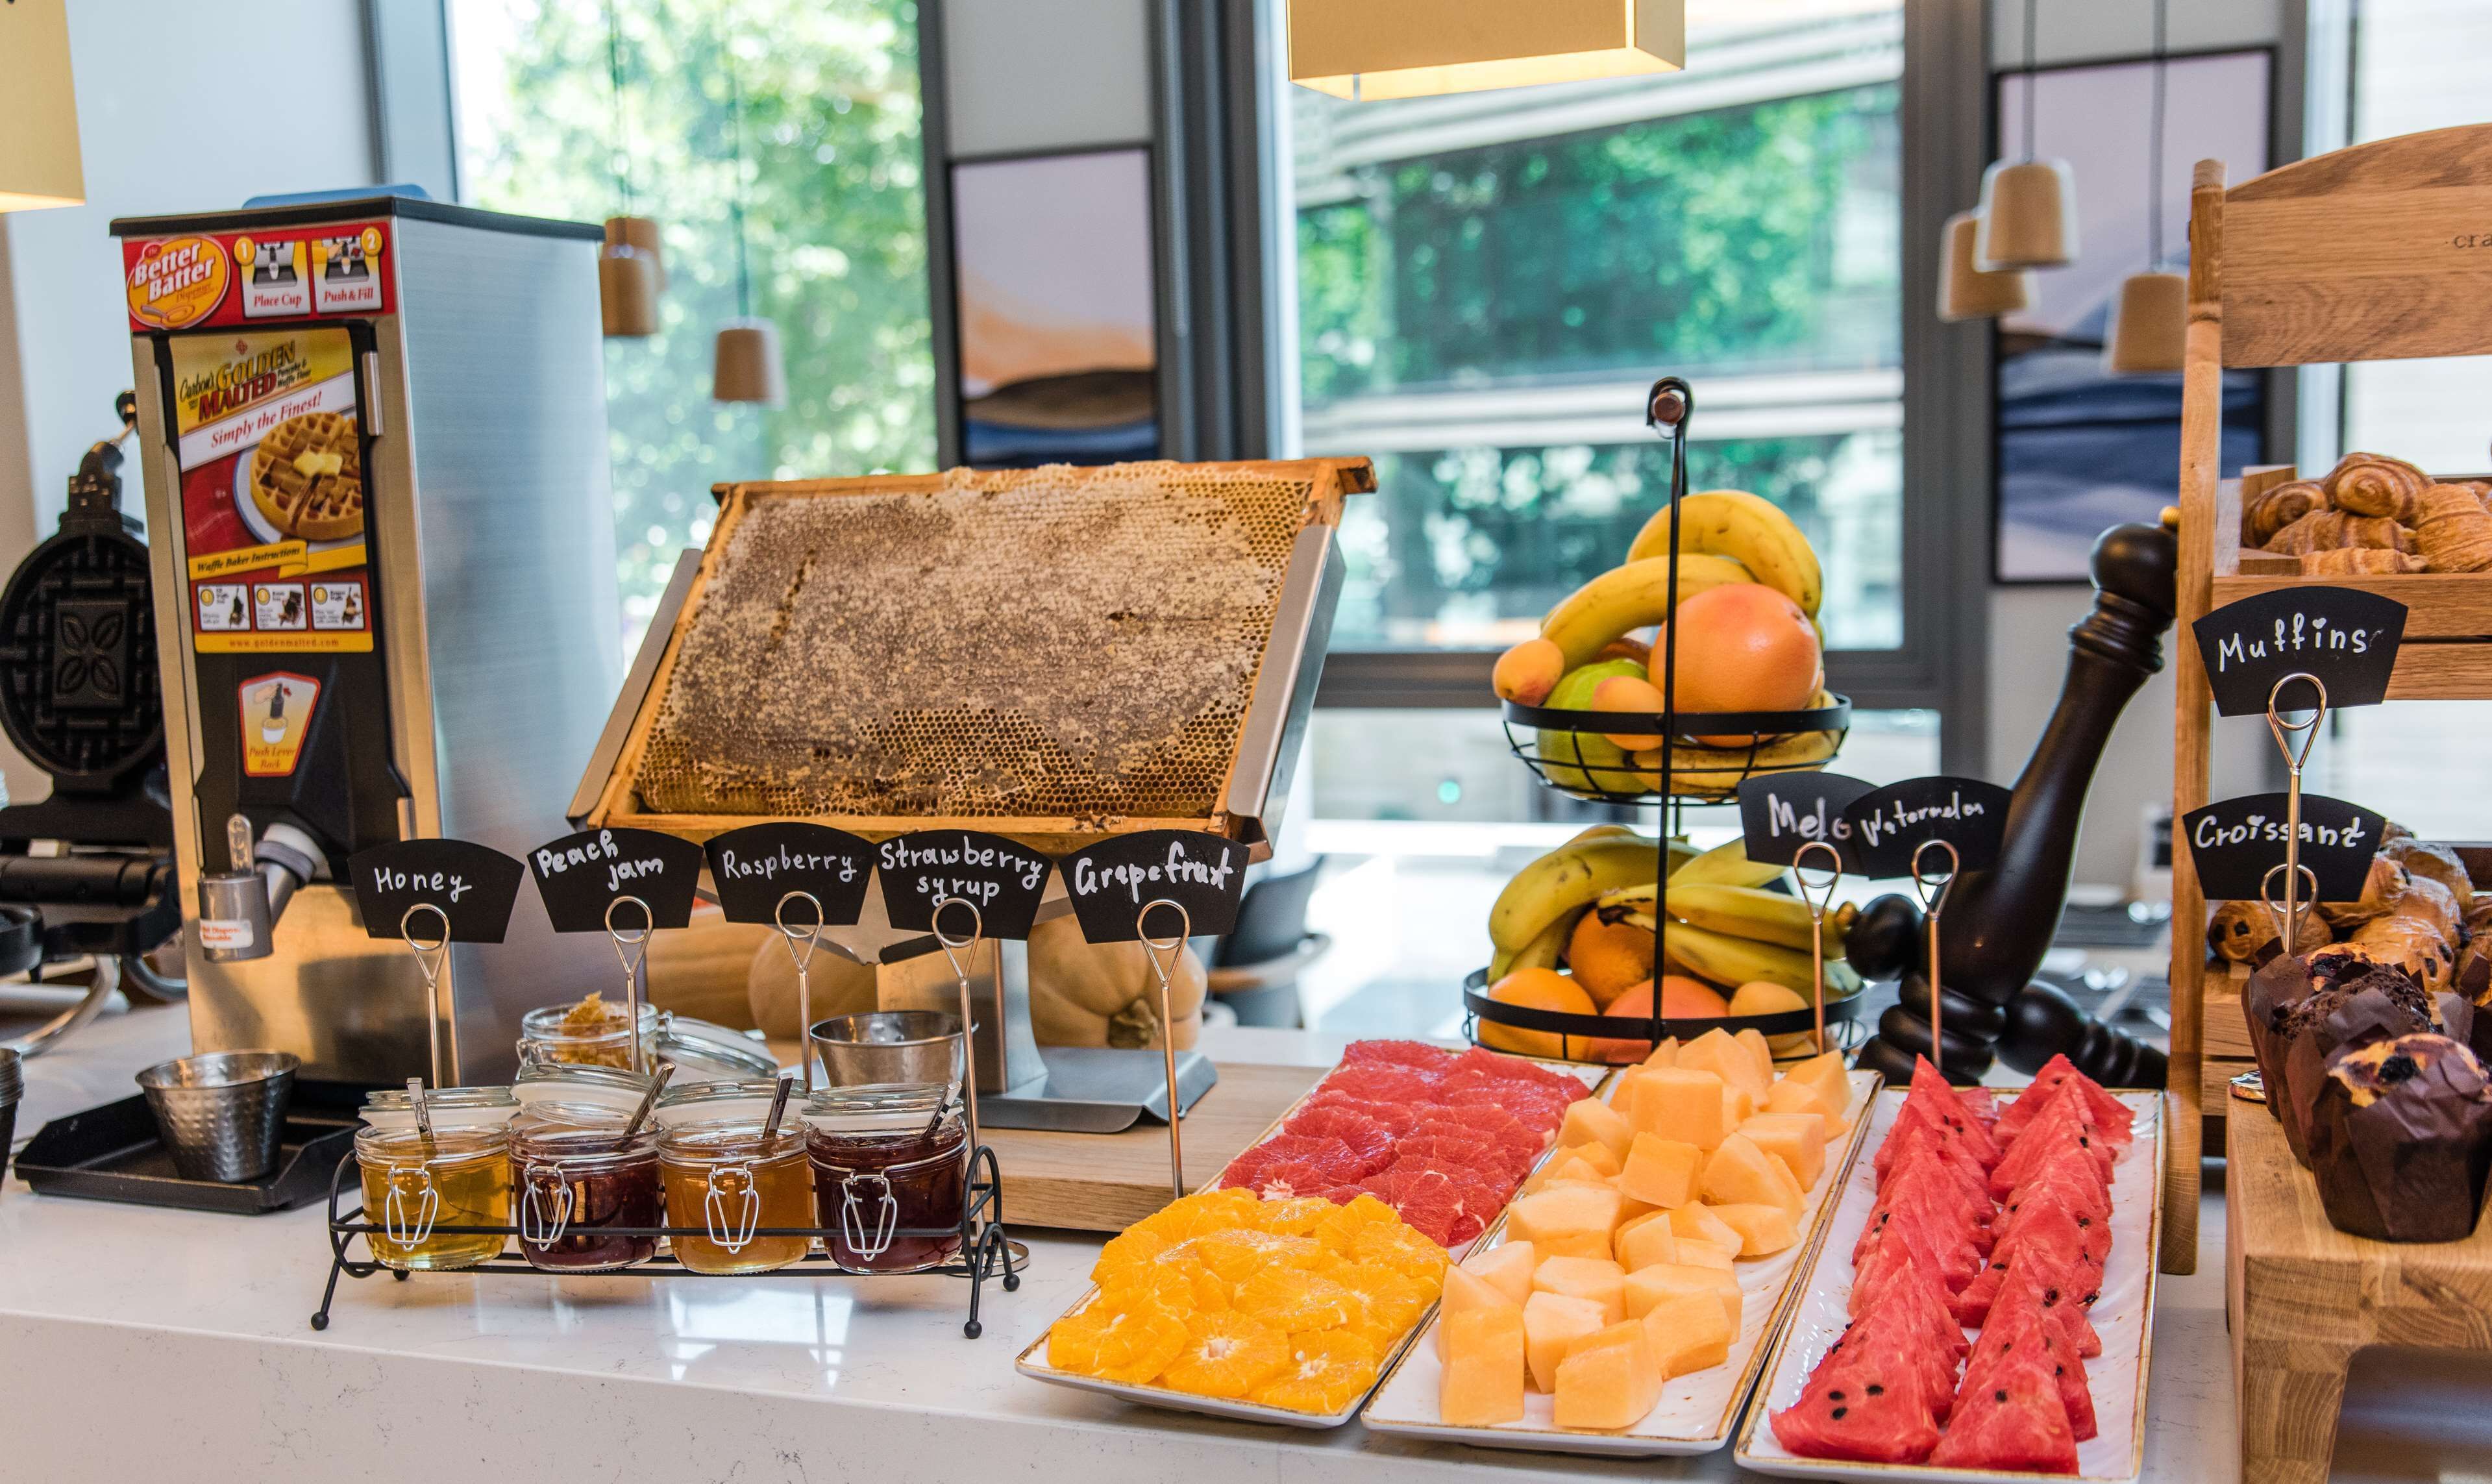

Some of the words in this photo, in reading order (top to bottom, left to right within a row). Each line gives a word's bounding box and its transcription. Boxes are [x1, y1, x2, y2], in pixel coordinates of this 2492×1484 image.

[241, 242, 248, 259] 1
[367, 231, 376, 251] 2
[134, 241, 201, 288] Better
[149, 258, 215, 303] Batter
[254, 294, 280, 308] Place
[282, 292, 302, 308] Cup
[325, 289, 347, 303] Push
[348, 291, 355, 301] &
[358, 287, 374, 301] Fill
[180, 371, 215, 403] Carbon's
[217, 340, 295, 392] GOLDEN
[199, 372, 277, 422] MALTED
[211, 419, 254, 448] Simply
[257, 411, 277, 430] the
[280, 391, 323, 421] Finest!
[197, 559, 223, 573] Waffle
[226, 556, 250, 567] Baker
[252, 547, 301, 563] Instructions
[2218, 612, 2367, 673] Muffins
[2194, 814, 2367, 848] Croissant
[536, 830, 619, 878] Peach
[722, 844, 857, 884] Raspberry
[880, 835, 1043, 891] Strawberry
[374, 867, 473, 903] Honey
[608, 857, 664, 892] jam
[916, 874, 1000, 908] syrup
